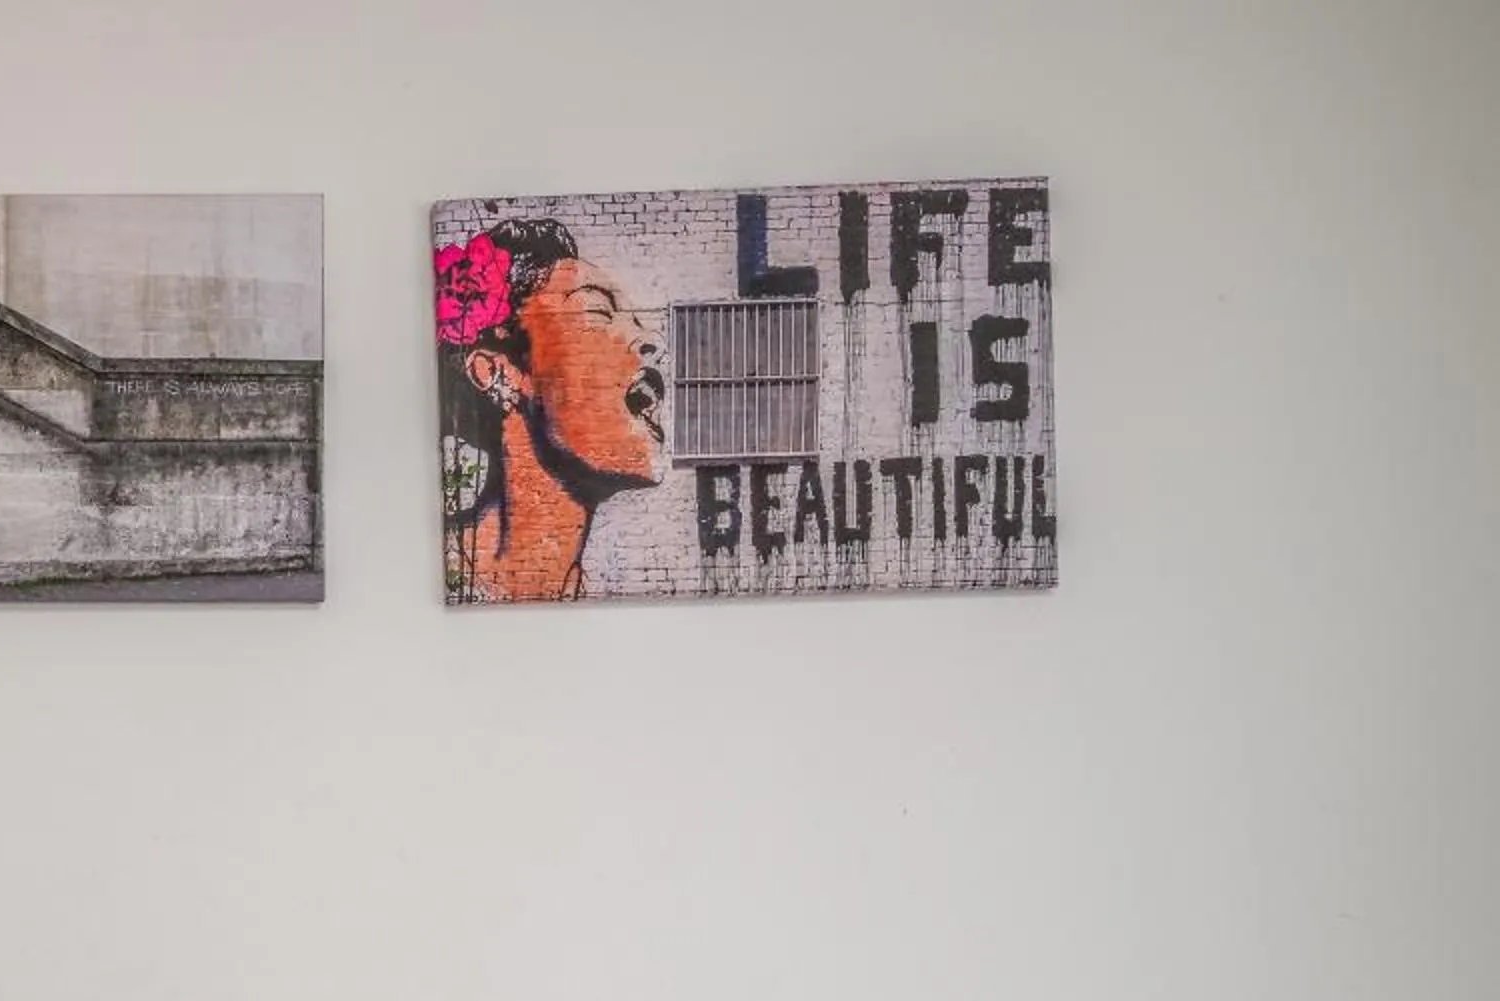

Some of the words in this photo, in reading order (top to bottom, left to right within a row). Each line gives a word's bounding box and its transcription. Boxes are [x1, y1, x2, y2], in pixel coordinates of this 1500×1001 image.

[736, 188, 1050, 299] LIFE
[186, 380, 262, 396] ALWAYS
[910, 314, 1030, 425] IS
[696, 455, 1056, 557] BEAUTIFUL
